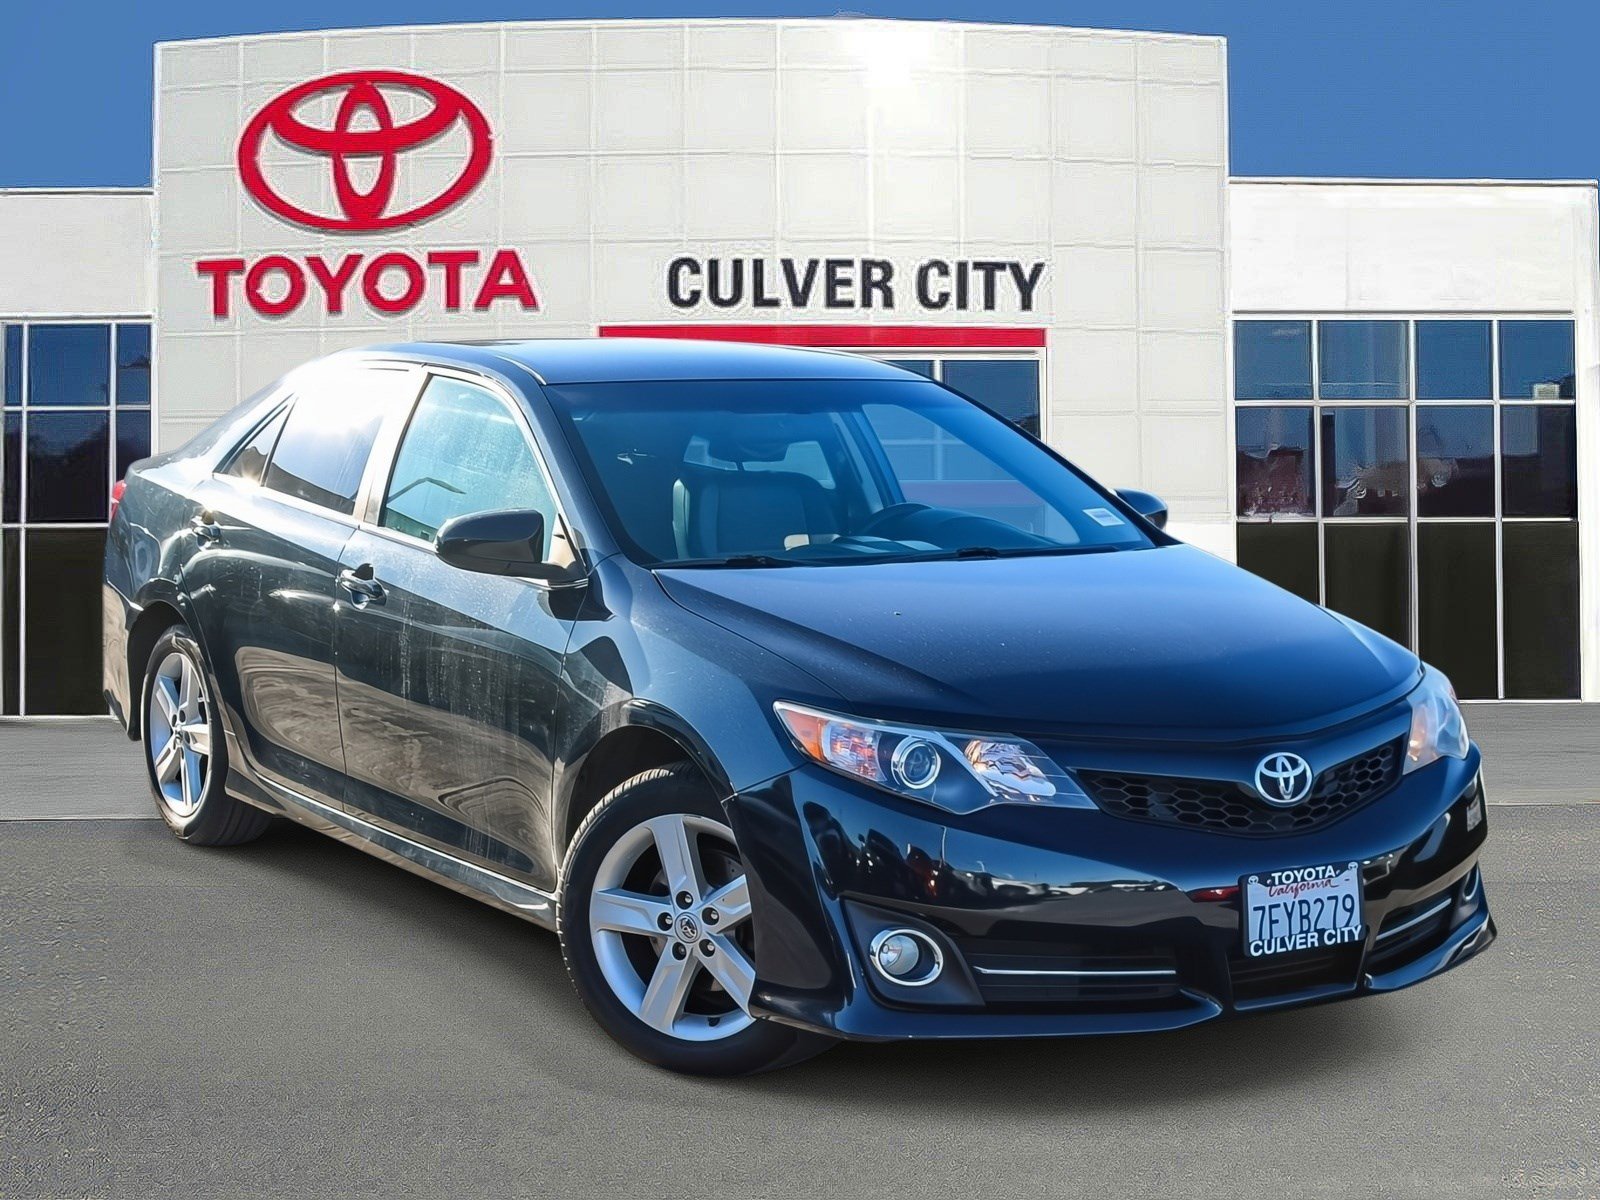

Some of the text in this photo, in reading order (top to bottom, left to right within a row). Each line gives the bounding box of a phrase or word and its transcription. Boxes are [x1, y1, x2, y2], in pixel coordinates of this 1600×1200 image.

[195, 250, 539, 319] TOYOTA
[667, 257, 1046, 312] CULVER CITY
[1268, 879, 1339, 898] California
[1271, 865, 1336, 885] TOYOTA
[1253, 894, 1355, 939] 7FYB279
[1250, 925, 1362, 957] CULVER CITY
